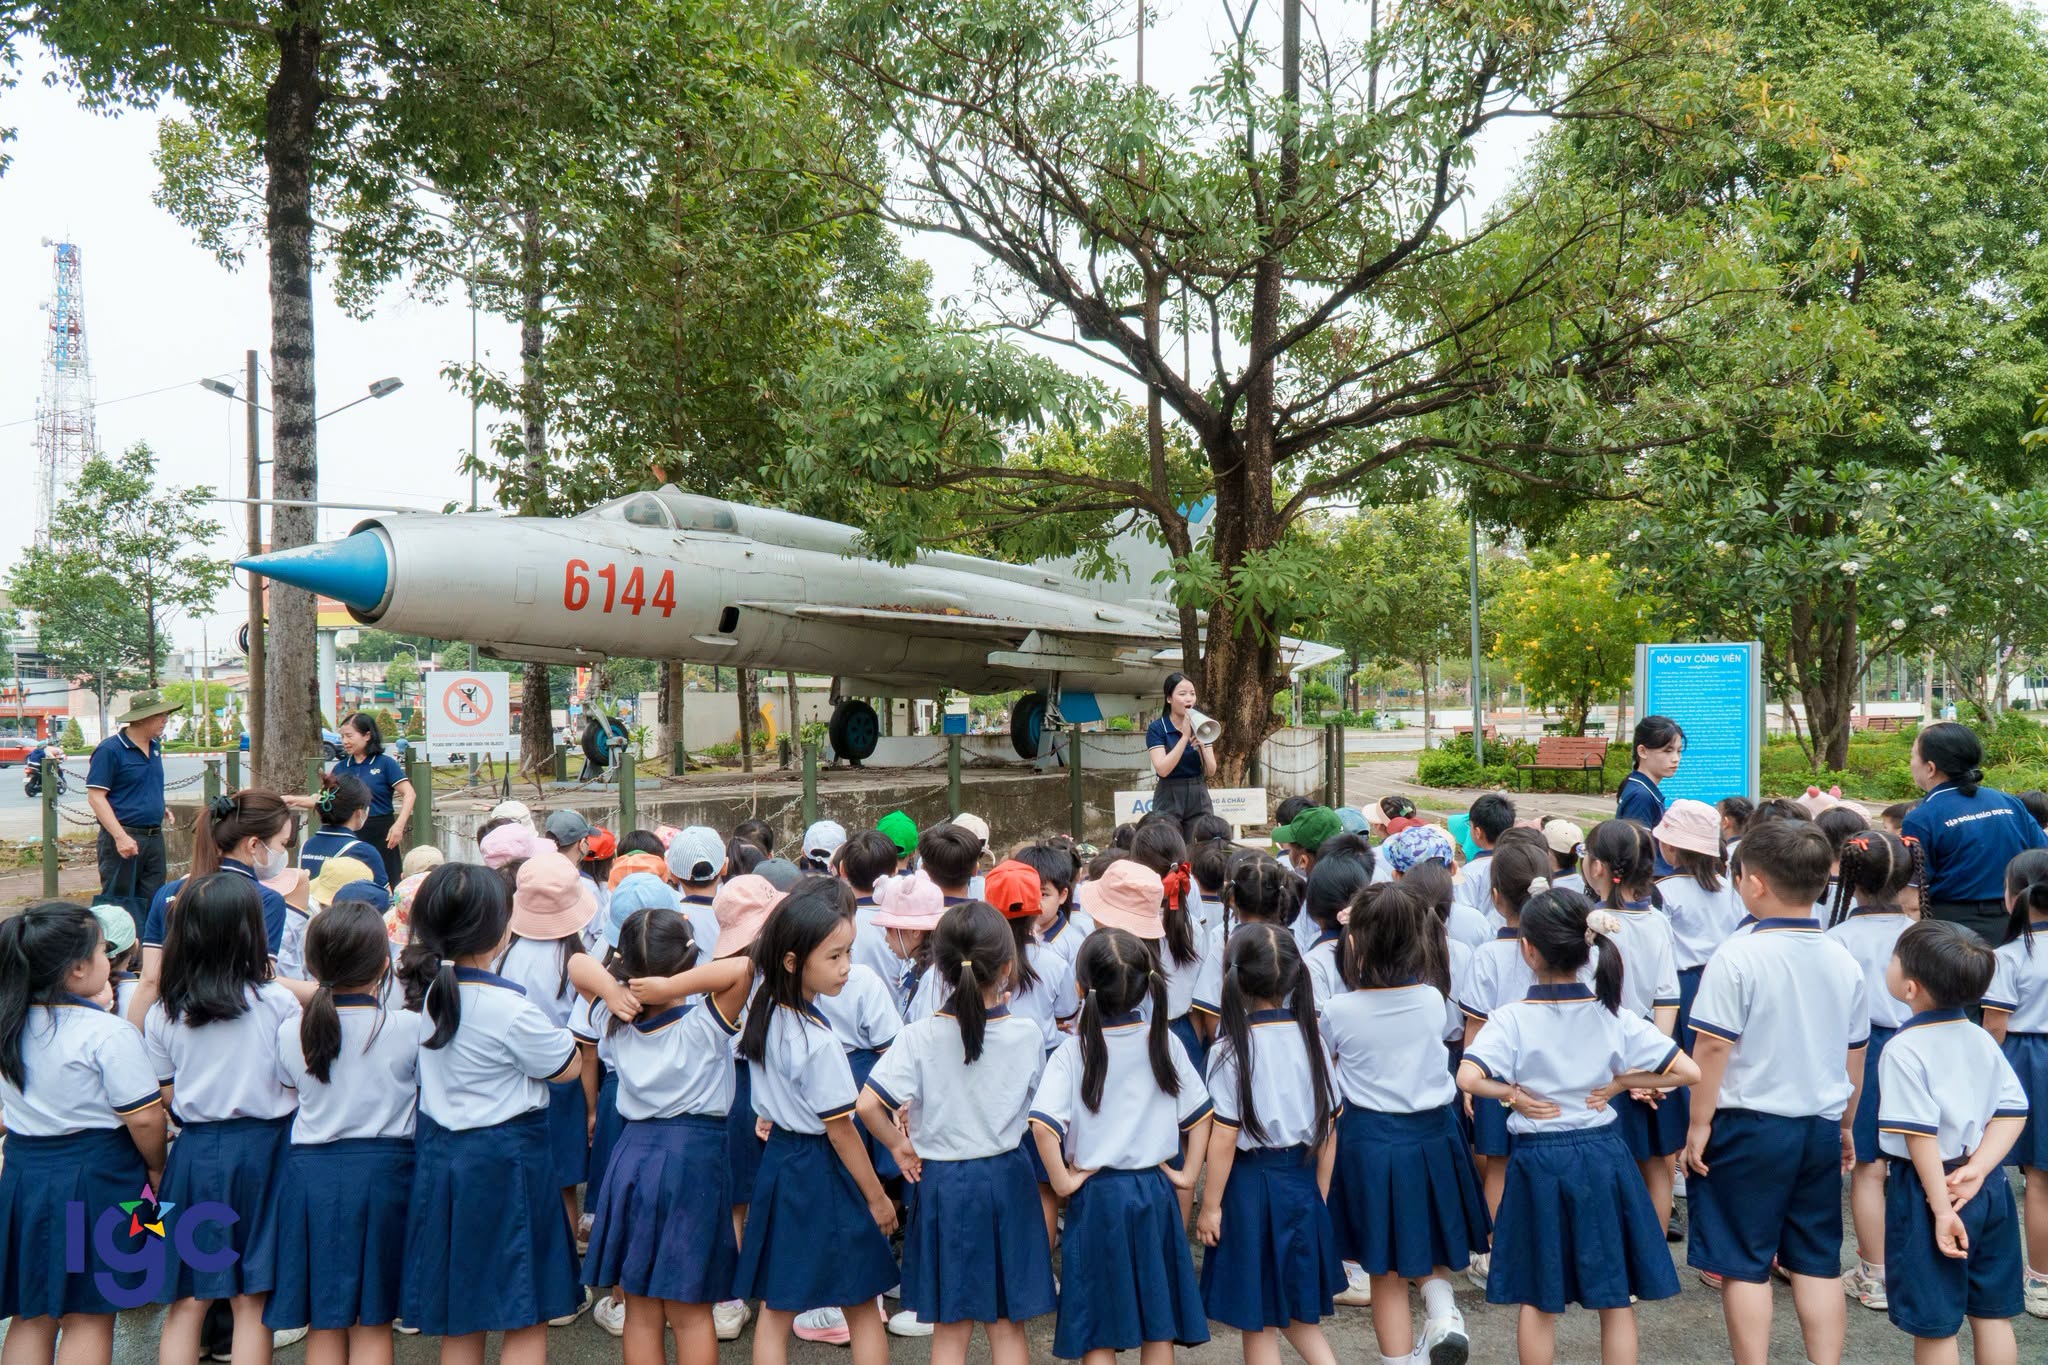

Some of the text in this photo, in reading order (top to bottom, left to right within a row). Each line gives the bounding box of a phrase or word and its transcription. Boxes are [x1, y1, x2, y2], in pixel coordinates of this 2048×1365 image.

[56, 261, 69, 372] VINAPHONE
[564, 559, 677, 618] 6144
[1656, 653, 1741, 664] NỘI QUY CÔNG VIÊN
[1132, 799, 1153, 814] AC
